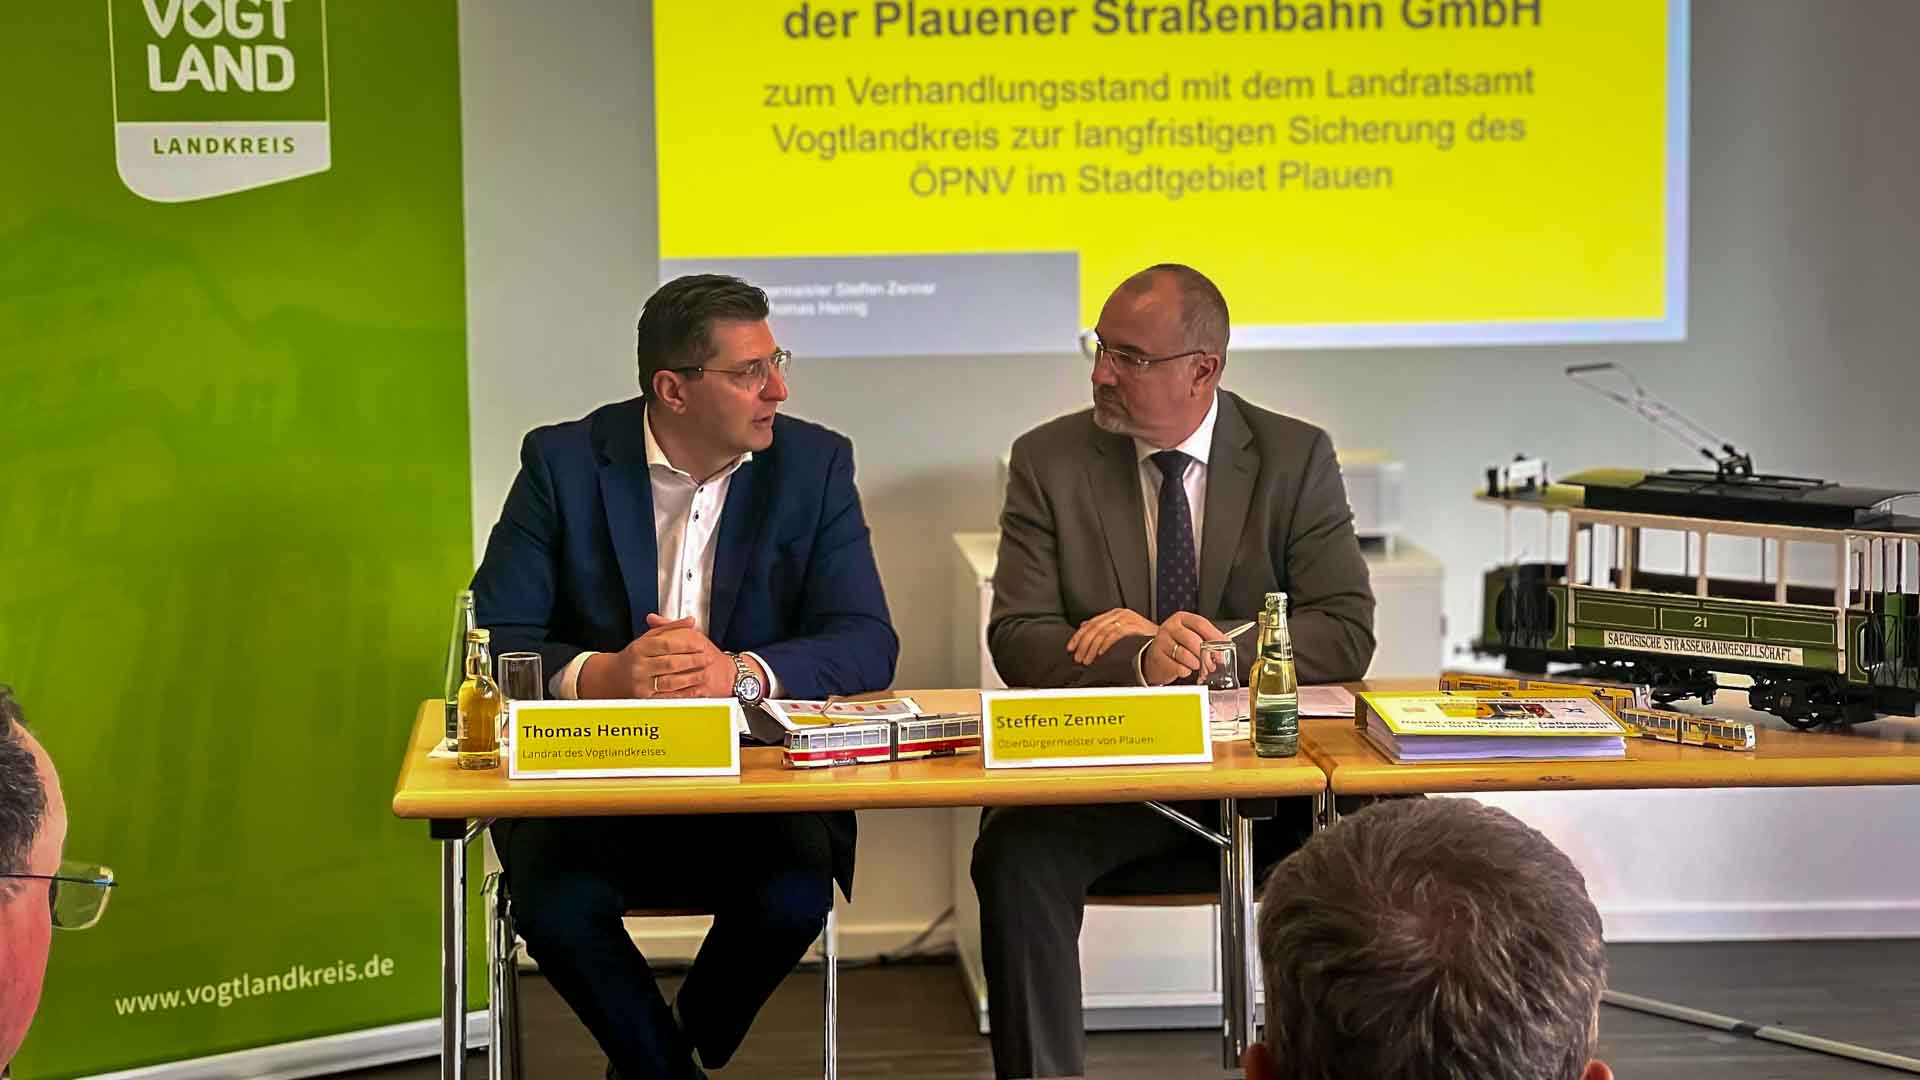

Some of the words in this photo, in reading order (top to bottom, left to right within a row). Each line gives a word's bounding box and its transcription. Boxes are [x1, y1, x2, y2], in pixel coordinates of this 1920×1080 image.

[142, 0, 290, 39] VOGT
[784, 2, 857, 38] der
[875, 0, 1076, 37] Plauener
[1092, 0, 1382, 35] Straßenbahn
[1401, 0, 1542, 29] GmbH
[147, 43, 295, 92] LAND
[763, 82, 835, 107] zum
[846, 72, 1169, 110] Verhandlungsstand
[1182, 71, 1231, 101] mit
[1242, 70, 1313, 100] dem
[1326, 67, 1535, 99] Landratsamt
[153, 136, 295, 155] LANDKREIS
[771, 121, 999, 160] Vogtlandkreis
[1011, 124, 1063, 150] zur
[1074, 117, 1276, 155] langfristigen
[1288, 115, 1456, 150] Sicherung
[1466, 113, 1526, 142] des
[909, 161, 1016, 197] ÖPNV
[1027, 165, 1066, 194] im
[1077, 161, 1267, 200] Stadtgebiet
[1278, 160, 1393, 191] Plauen
[769, 301, 815, 316] homas
[1693, 616, 1708, 628] 21
[1608, 632, 1661, 649] SAECHSISCHE
[1663, 637, 1792, 662] STRASSENBAHNGESELLSCHAFT
[522, 723, 592, 740] Thomas
[597, 723, 660, 741] Hennig
[996, 714, 1059, 729] Steffen
[1063, 713, 1126, 728] Zenner
[522, 748, 561, 760] Landrat
[564, 747, 584, 759] des
[585, 746, 666, 760] Vogtlandkreises
[1097, 736, 1117, 746] von
[1119, 735, 1155, 746] Plauen
[115, 954, 394, 1015] www.vogtlandkreis.de
